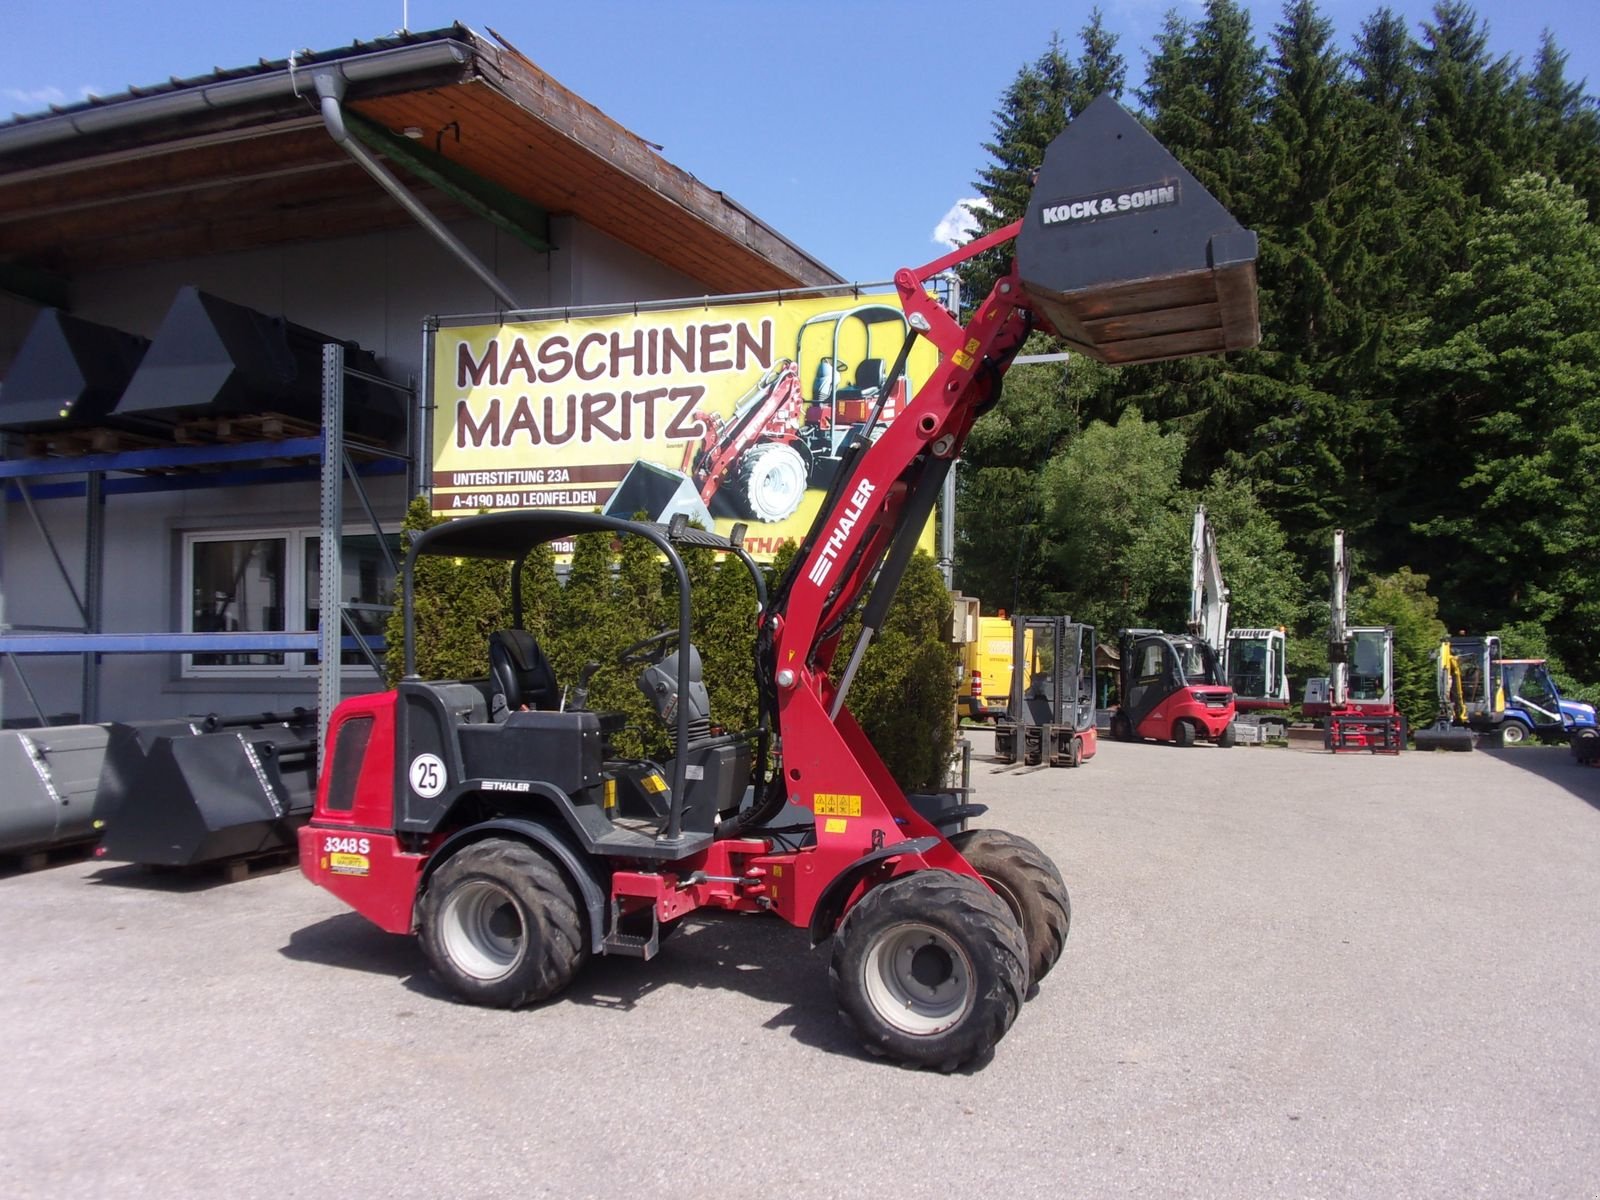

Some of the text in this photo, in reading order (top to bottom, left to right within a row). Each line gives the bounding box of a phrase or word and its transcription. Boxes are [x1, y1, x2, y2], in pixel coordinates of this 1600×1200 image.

[1042, 186, 1175, 224] KOCK & SOHN
[457, 320, 772, 388] MASCHINEN
[457, 385, 707, 448] MAURITZ
[453, 469, 570, 486] UNTERSTIFTUNG 23A
[452, 491, 597, 508] A-4190 BAD LEONFELDEN
[821, 478, 876, 559] THALER
[418, 762, 438, 789] 25
[492, 781, 530, 792] THALER
